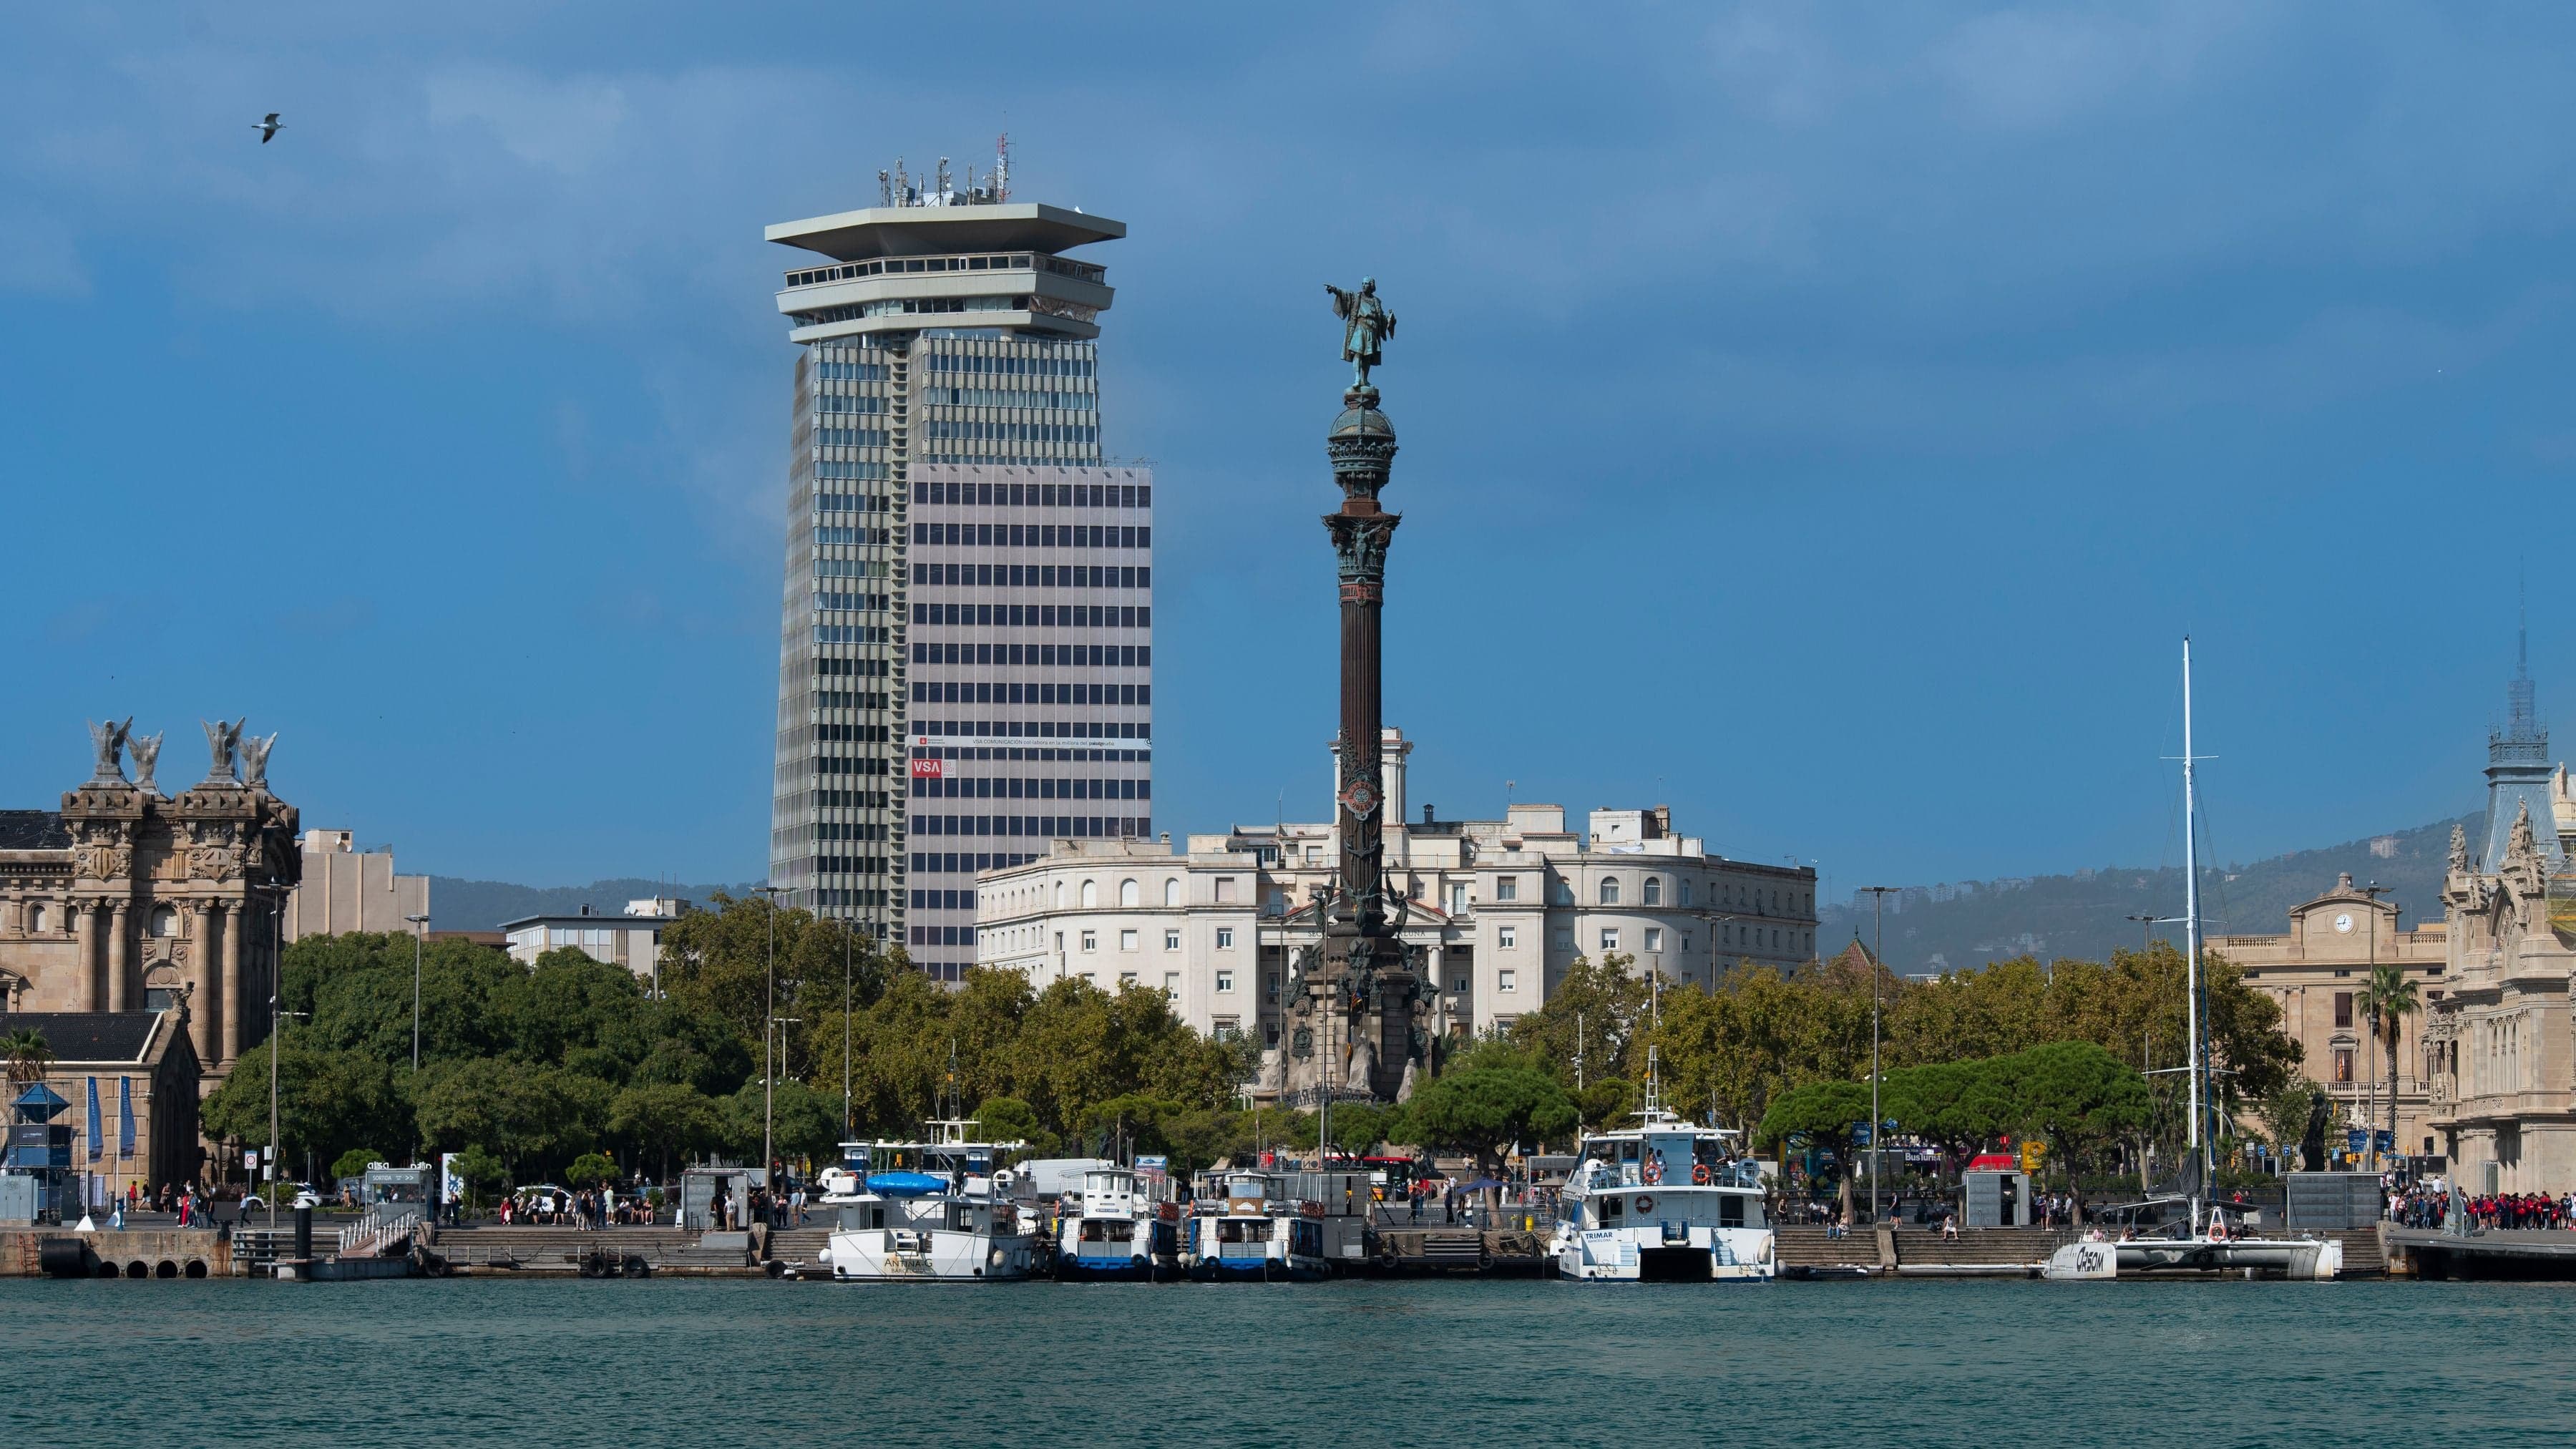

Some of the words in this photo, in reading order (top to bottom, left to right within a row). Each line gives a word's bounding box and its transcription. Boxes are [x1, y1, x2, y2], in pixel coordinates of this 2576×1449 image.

[914, 761, 940, 772] VSA
[367, 1161, 389, 1170] alsa
[884, 1258, 933, 1267] ANTINA-G
[2077, 1246, 2104, 1272] ORSOM
[2391, 1259, 2406, 1272] ME
